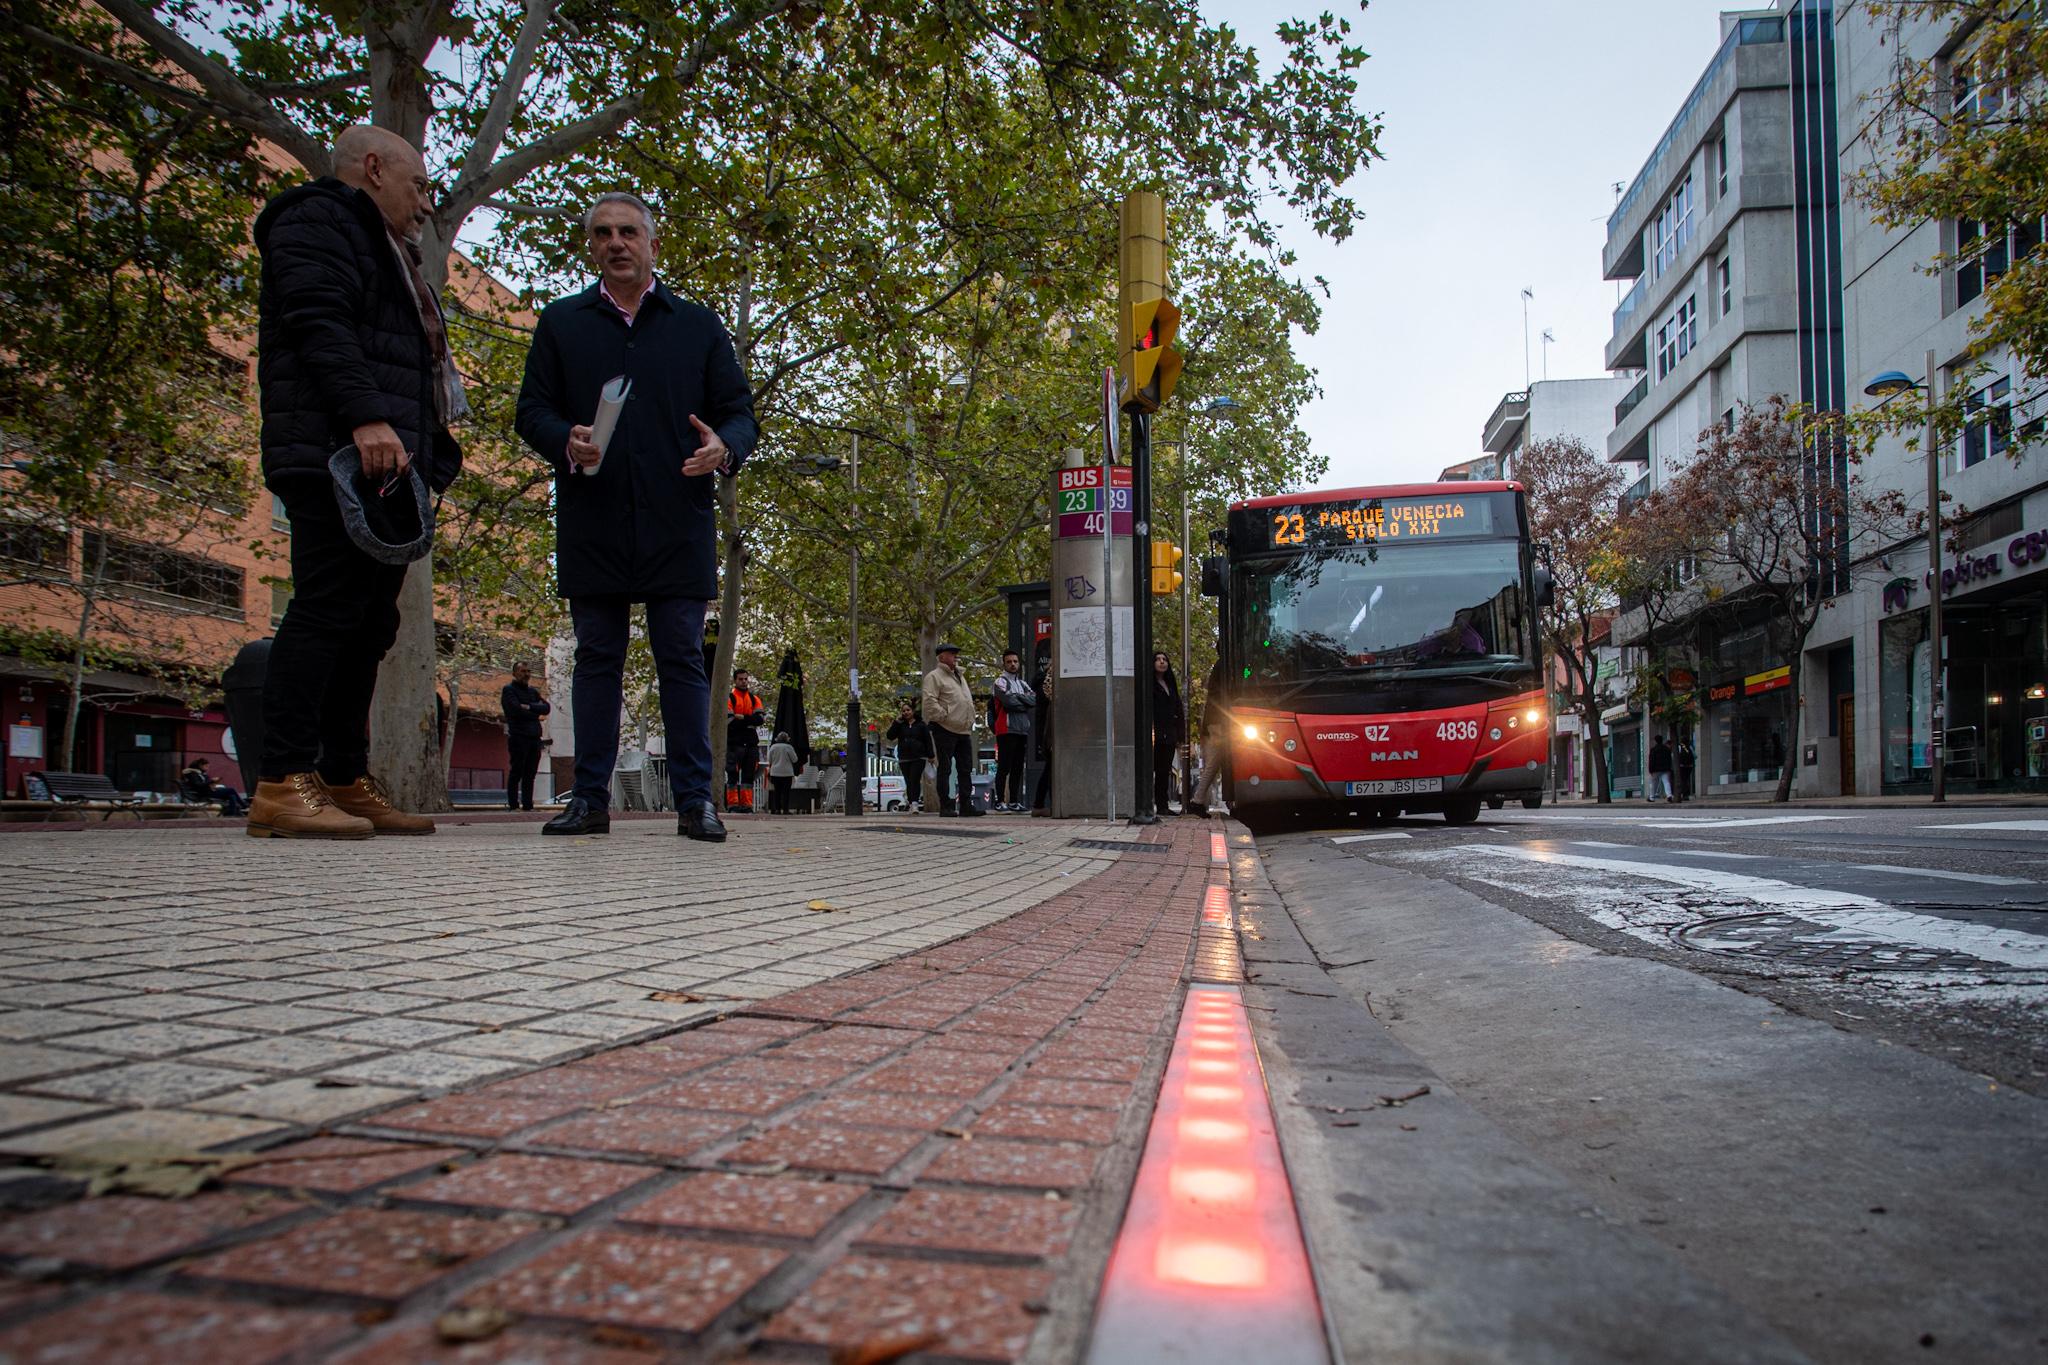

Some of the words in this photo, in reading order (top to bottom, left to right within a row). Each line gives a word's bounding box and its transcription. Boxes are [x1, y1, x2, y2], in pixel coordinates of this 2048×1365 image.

[1062, 469, 1098, 488] BUS
[1065, 490, 1088, 512] 23
[1083, 513, 1105, 534] 40
[1318, 507, 1385, 527] PARQUE
[1391, 503, 1466, 522] VENECIA
[1274, 514, 1306, 545] 23
[1345, 522, 1400, 541] SIGLO
[1408, 518, 1441, 536] XXI
[1710, 684, 1736, 701] Orange
[1317, 731, 1350, 740] avanza
[1378, 725, 1390, 742] Z
[1436, 720, 1478, 741] 4836
[1371, 750, 1419, 762] MAN
[1356, 783, 1384, 794] 6712
[1390, 780, 1411, 793] JBS
